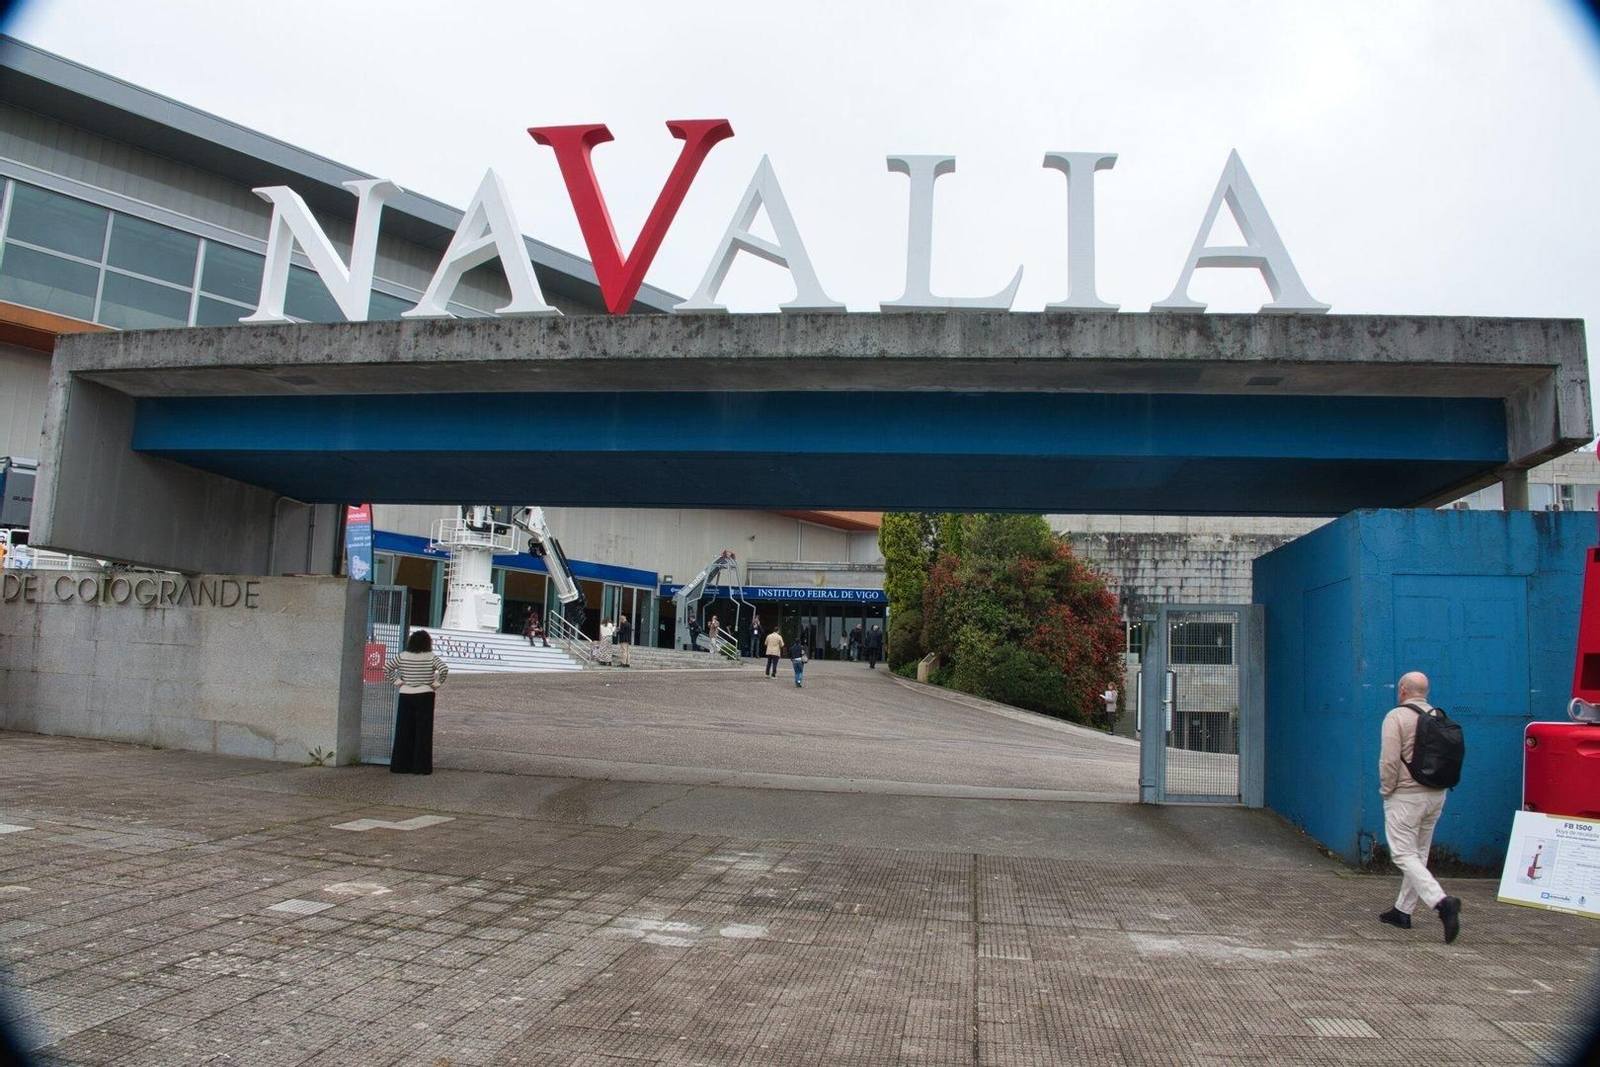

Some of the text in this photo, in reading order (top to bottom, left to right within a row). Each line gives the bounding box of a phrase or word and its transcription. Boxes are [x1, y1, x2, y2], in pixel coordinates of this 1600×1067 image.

[239, 119, 1331, 323] NAVALIA
[2, 574, 38, 603] DE
[758, 588, 805, 598] INSTITUTO
[807, 589, 839, 599] FEIRAL
[841, 590, 853, 599] DE
[856, 591, 879, 600] VIGO
[1576, 823, 1593, 832] 1500
